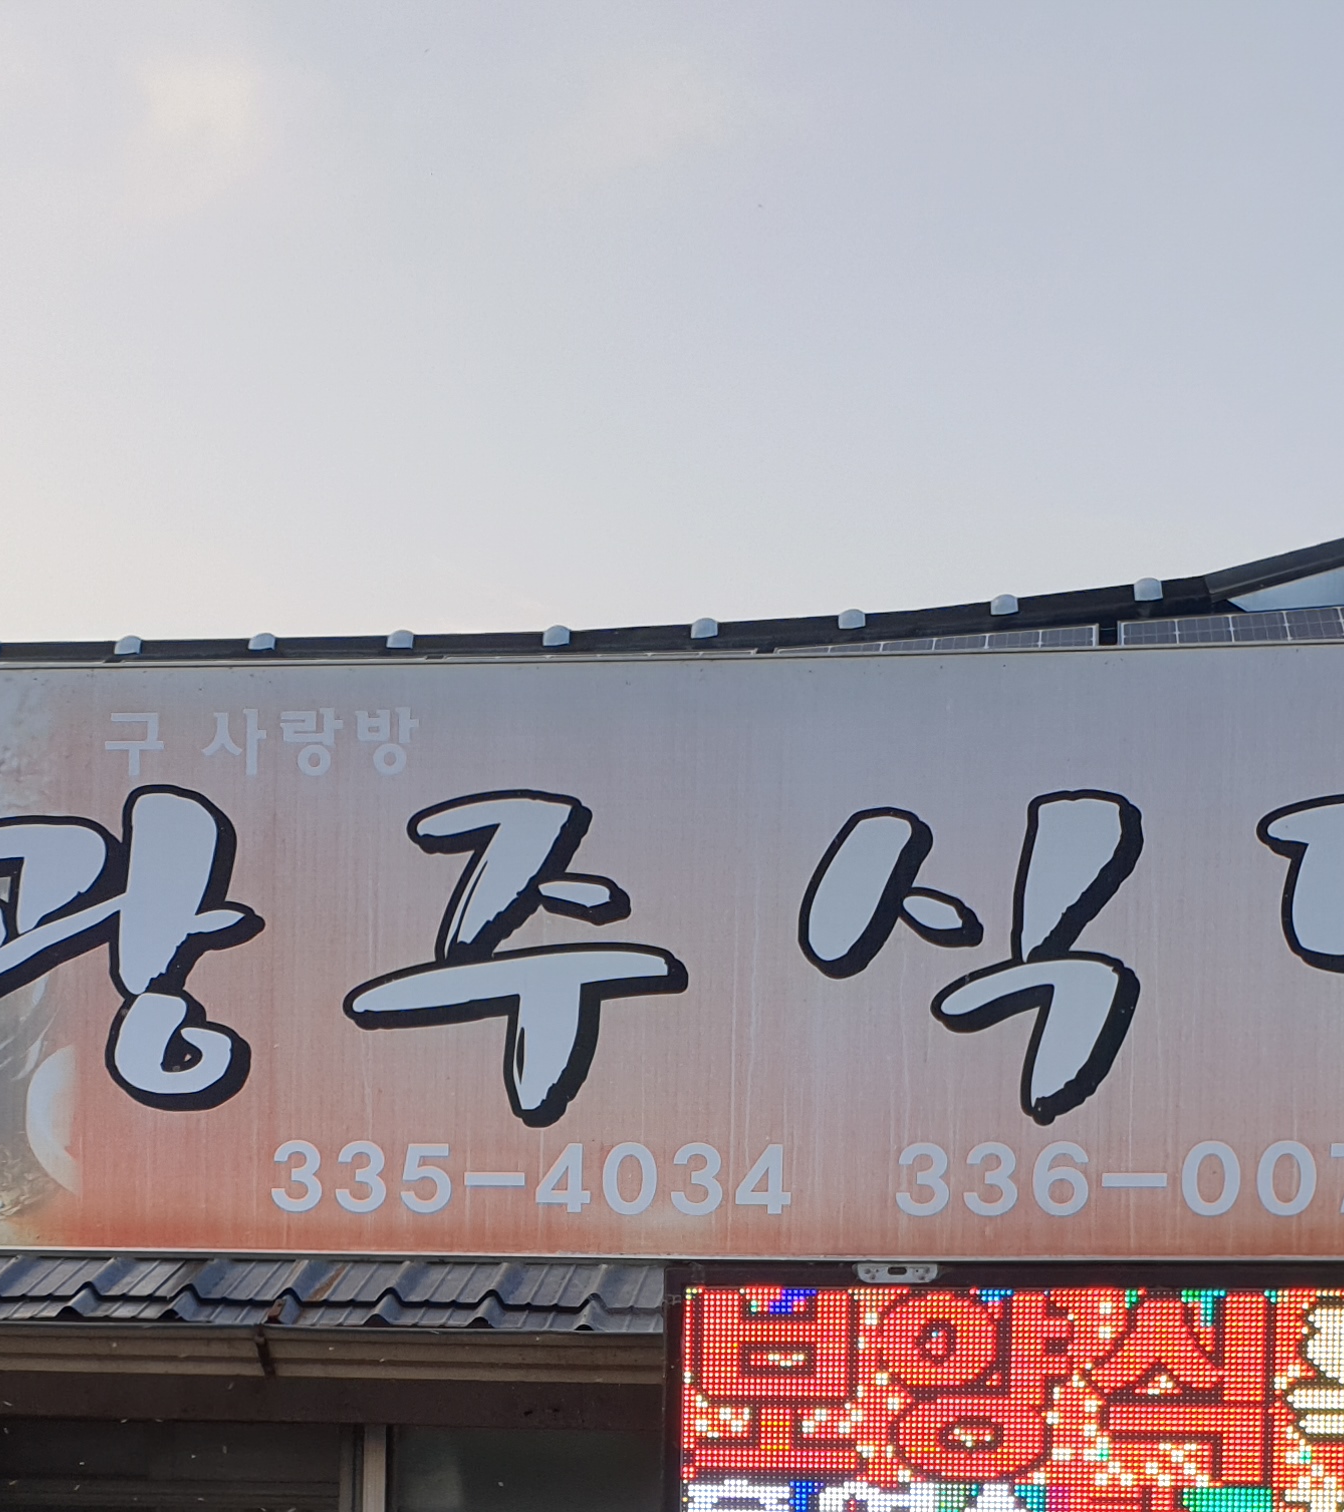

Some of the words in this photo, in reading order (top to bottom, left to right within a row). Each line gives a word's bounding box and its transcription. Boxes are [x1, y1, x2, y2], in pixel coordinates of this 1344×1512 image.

[105, 712, 164, 777] 구
[201, 706, 419, 778] 사랑방
[270, 1139, 792, 1217] 335-4034
